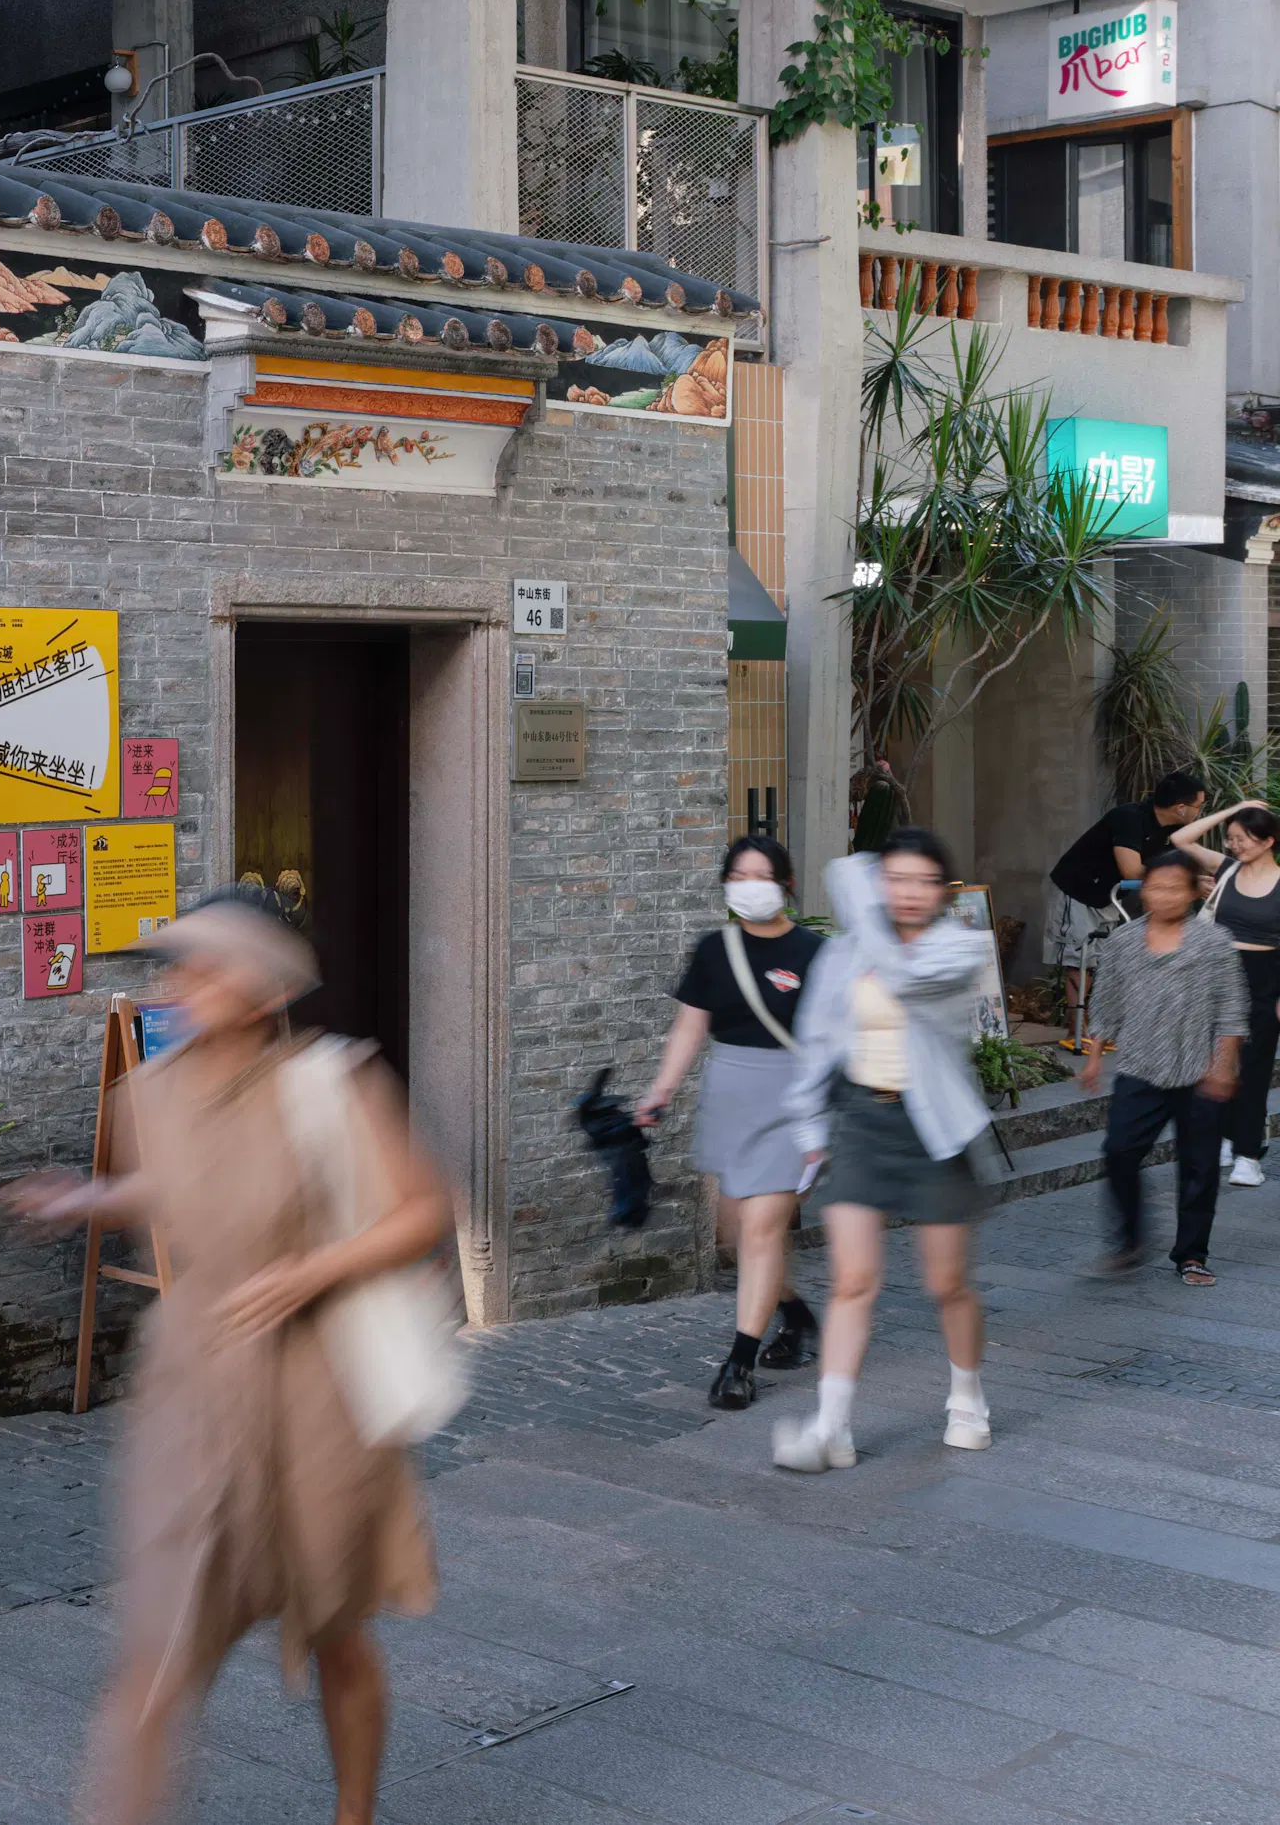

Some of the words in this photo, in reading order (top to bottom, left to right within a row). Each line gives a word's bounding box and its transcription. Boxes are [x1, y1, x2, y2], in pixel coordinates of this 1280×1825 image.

[1058, 13, 1147, 59] BUGHUB
[1093, 41, 1147, 80] bar
[1059, 44, 1128, 97] 爪
[1088, 451, 1156, 505] 虫影
[517, 587, 551, 601] 中山东街
[526, 609, 542, 626] 46
[523, 730, 580, 743] 中山东街46号住宅
[132, 743, 154, 758] 进来
[132, 761, 154, 775] 坐坐
[56, 833, 78, 848] 成为
[57, 850, 78, 865] 厅长
[33, 921, 55, 936] 进群
[33, 938, 56, 954] 冲浪
